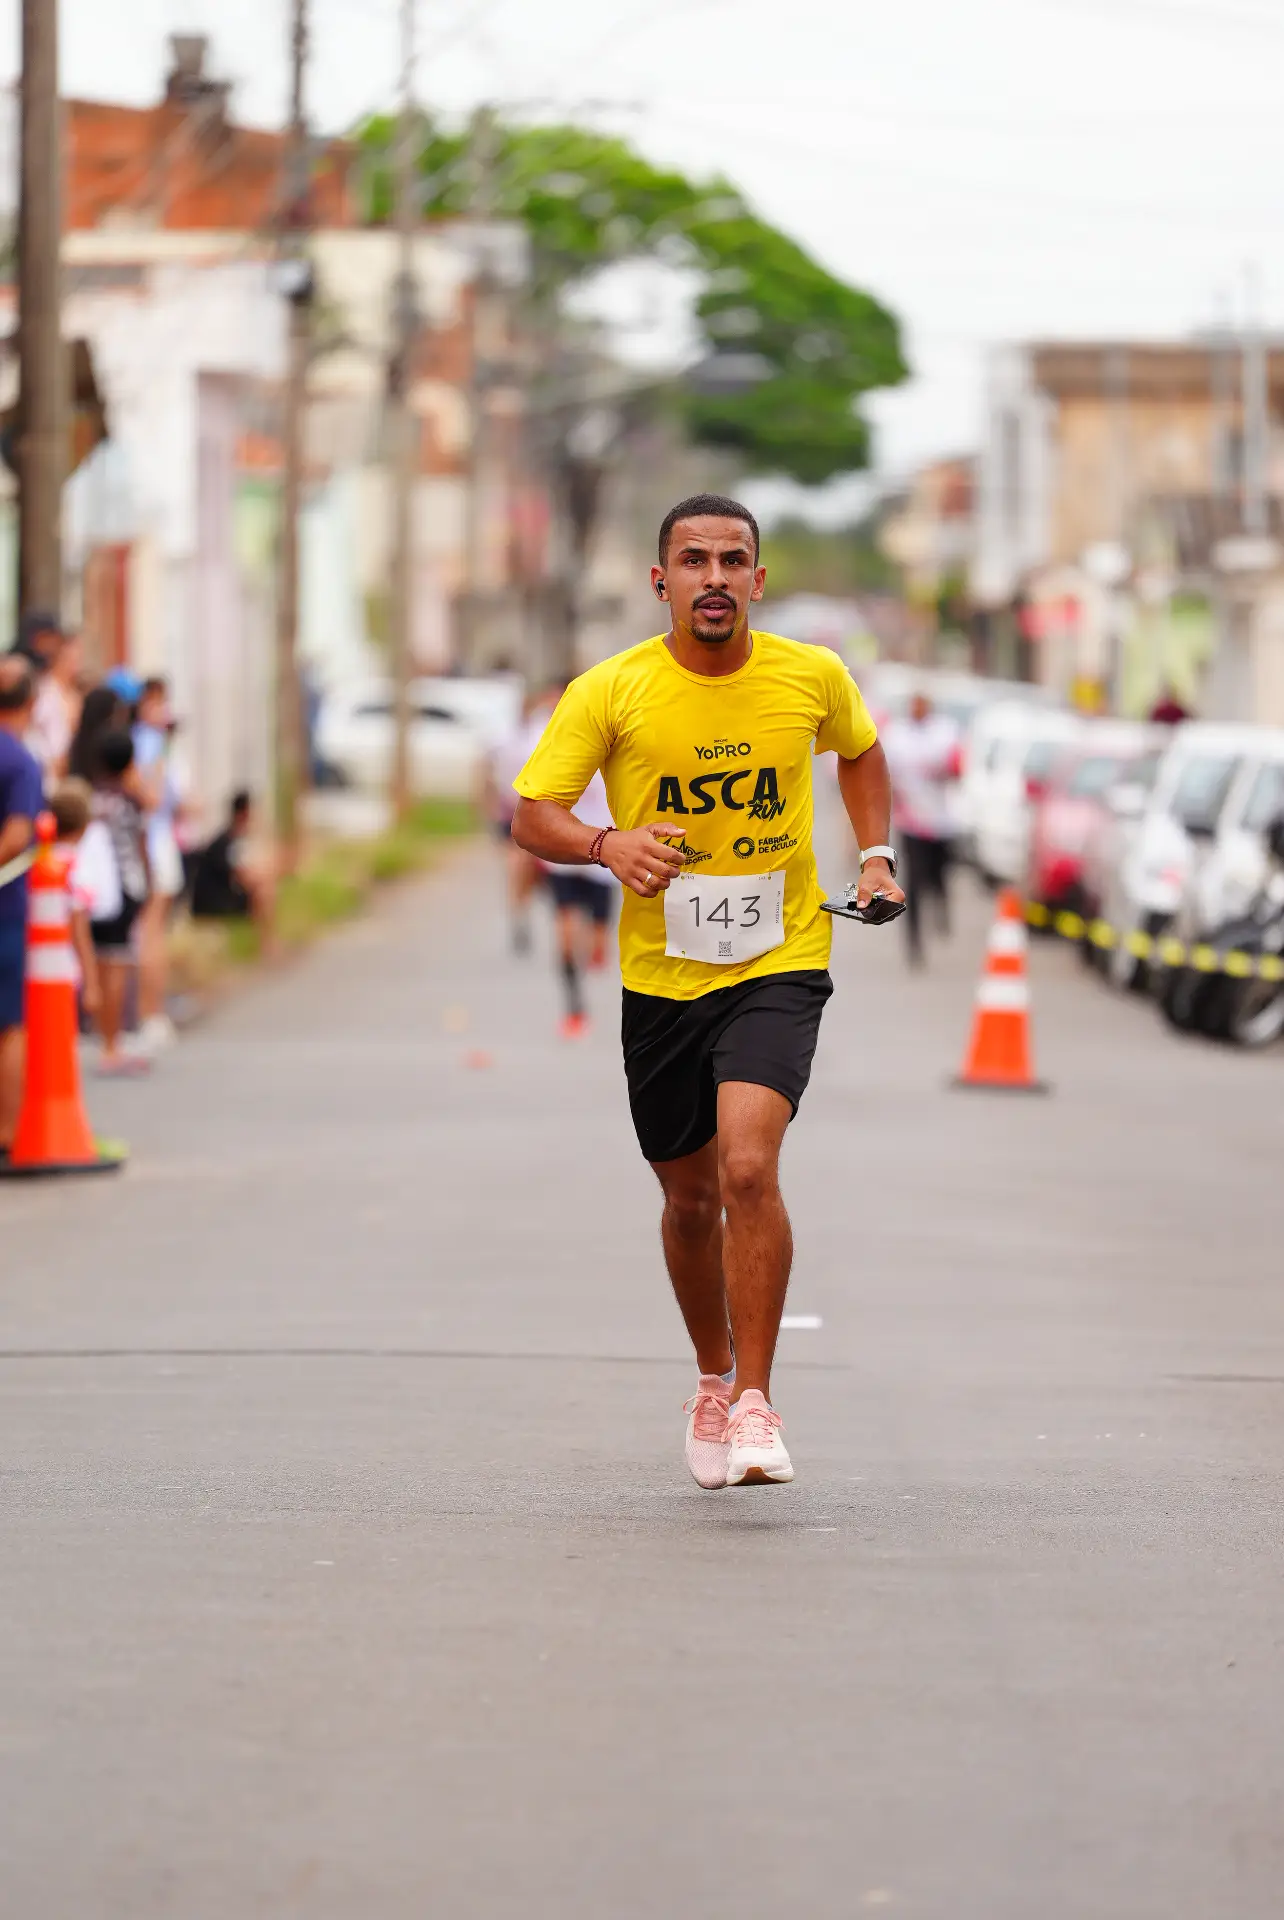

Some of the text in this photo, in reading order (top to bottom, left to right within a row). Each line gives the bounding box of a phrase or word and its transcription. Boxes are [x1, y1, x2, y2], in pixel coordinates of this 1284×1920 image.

[694, 742, 751, 759] YoPRO
[656, 767, 779, 815] ASCA
[747, 797, 787, 821] RUN
[758, 833, 790, 846] FÁBRICA
[771, 839, 798, 852] ÓCULOS
[689, 895, 761, 930] 143
